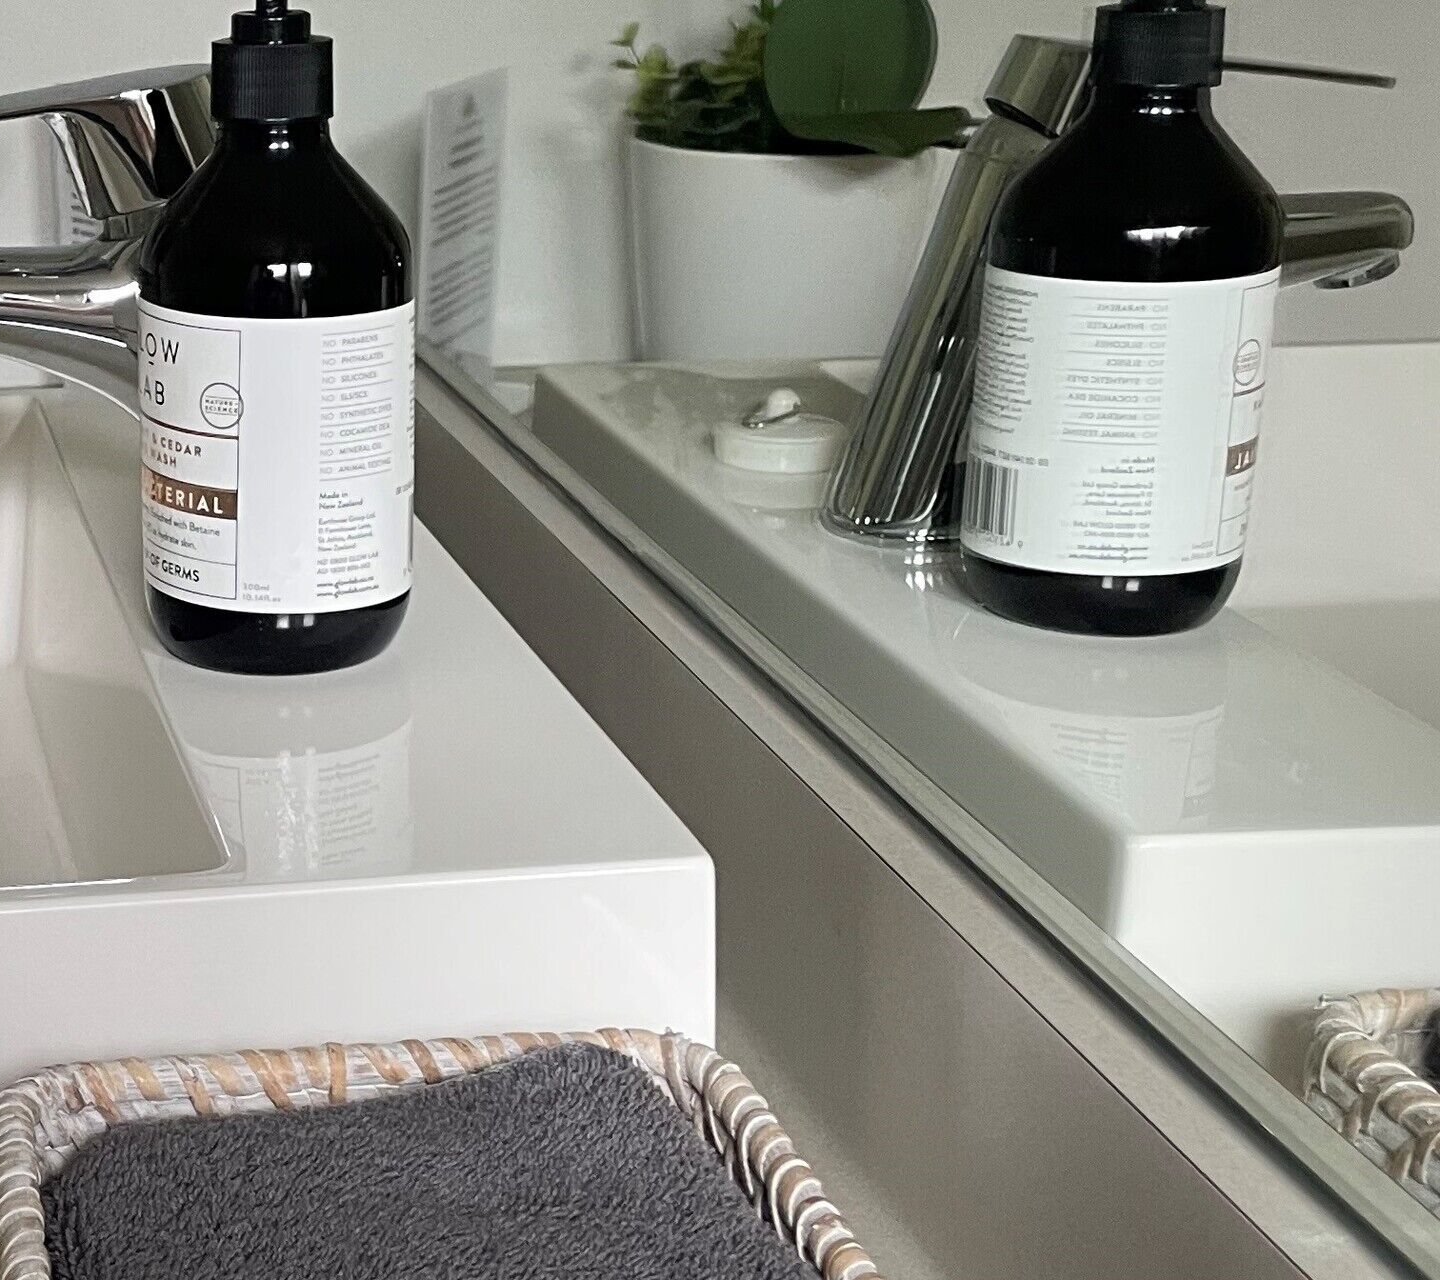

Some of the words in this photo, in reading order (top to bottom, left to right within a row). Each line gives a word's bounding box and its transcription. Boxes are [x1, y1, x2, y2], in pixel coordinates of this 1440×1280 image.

[140, 333, 179, 365] OW
[161, 438, 202, 457] CEDAR
[338, 498, 363, 507] Zealand
[189, 522, 220, 536] Betaine
[162, 560, 200, 582] GERMS
